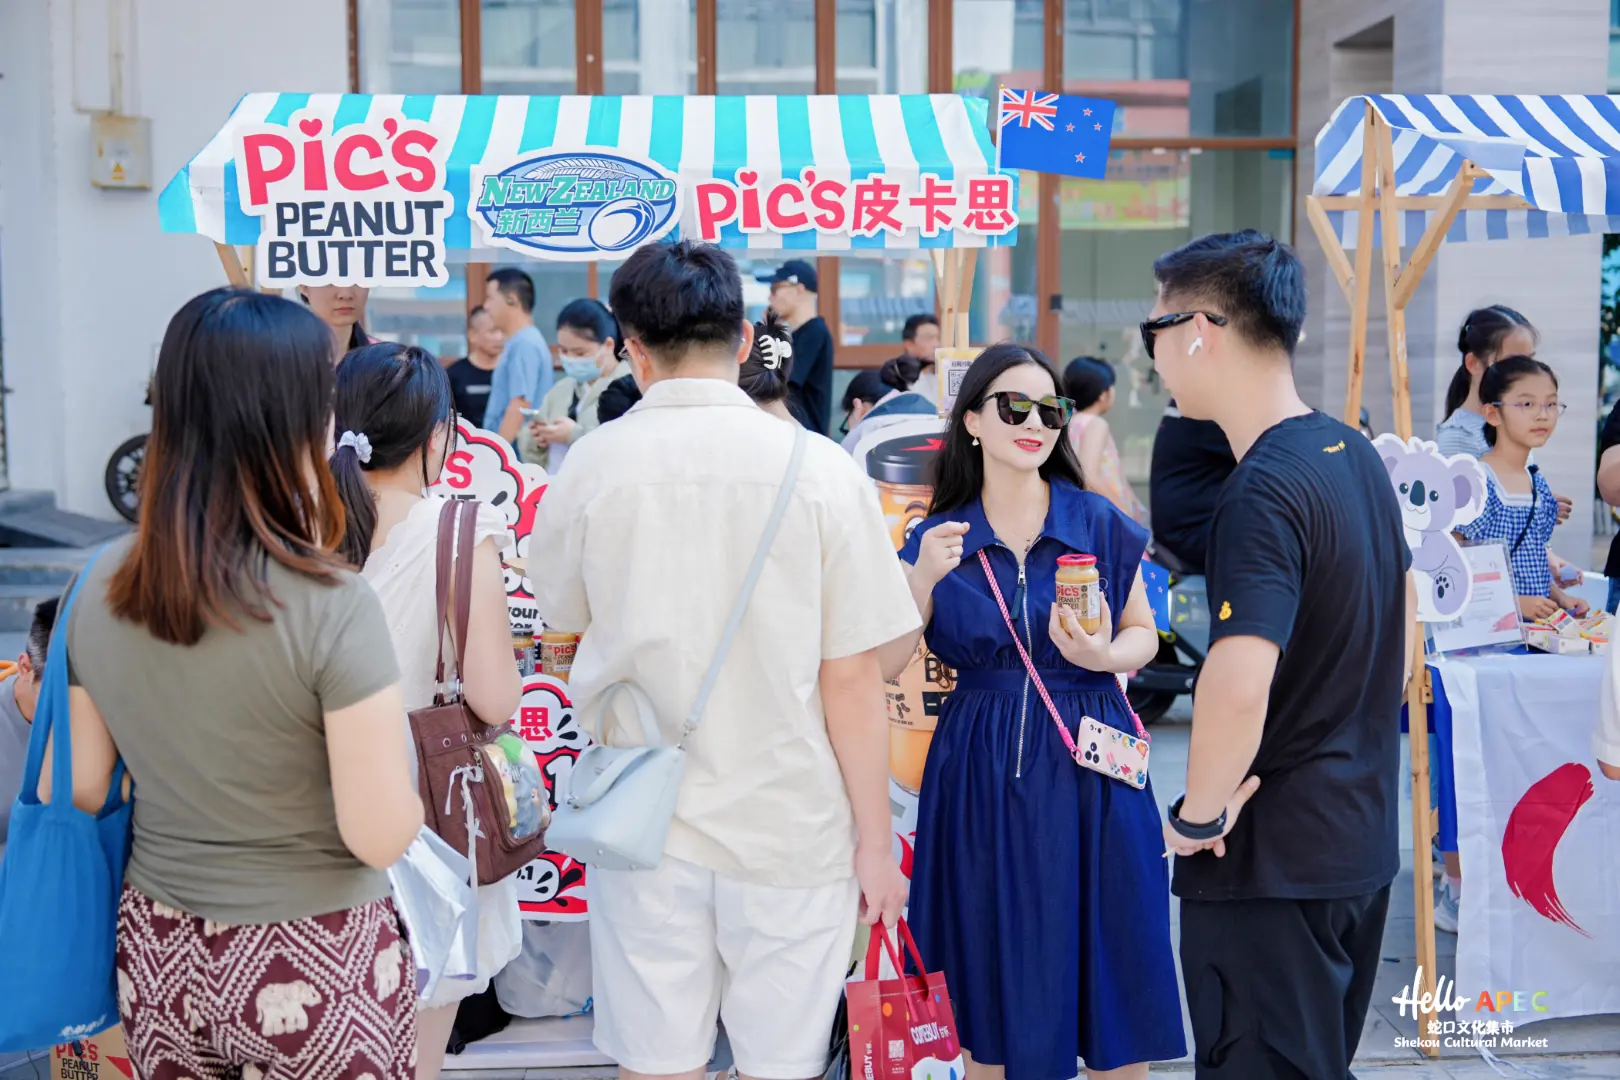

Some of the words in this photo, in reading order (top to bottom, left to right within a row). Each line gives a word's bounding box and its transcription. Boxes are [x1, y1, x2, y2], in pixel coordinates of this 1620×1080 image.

[276, 201, 444, 237] PEANUT
[495, 208, 580, 235] 新西兰
[852, 177, 1014, 233] 皮卡思
[268, 240, 438, 278] BUTTER
